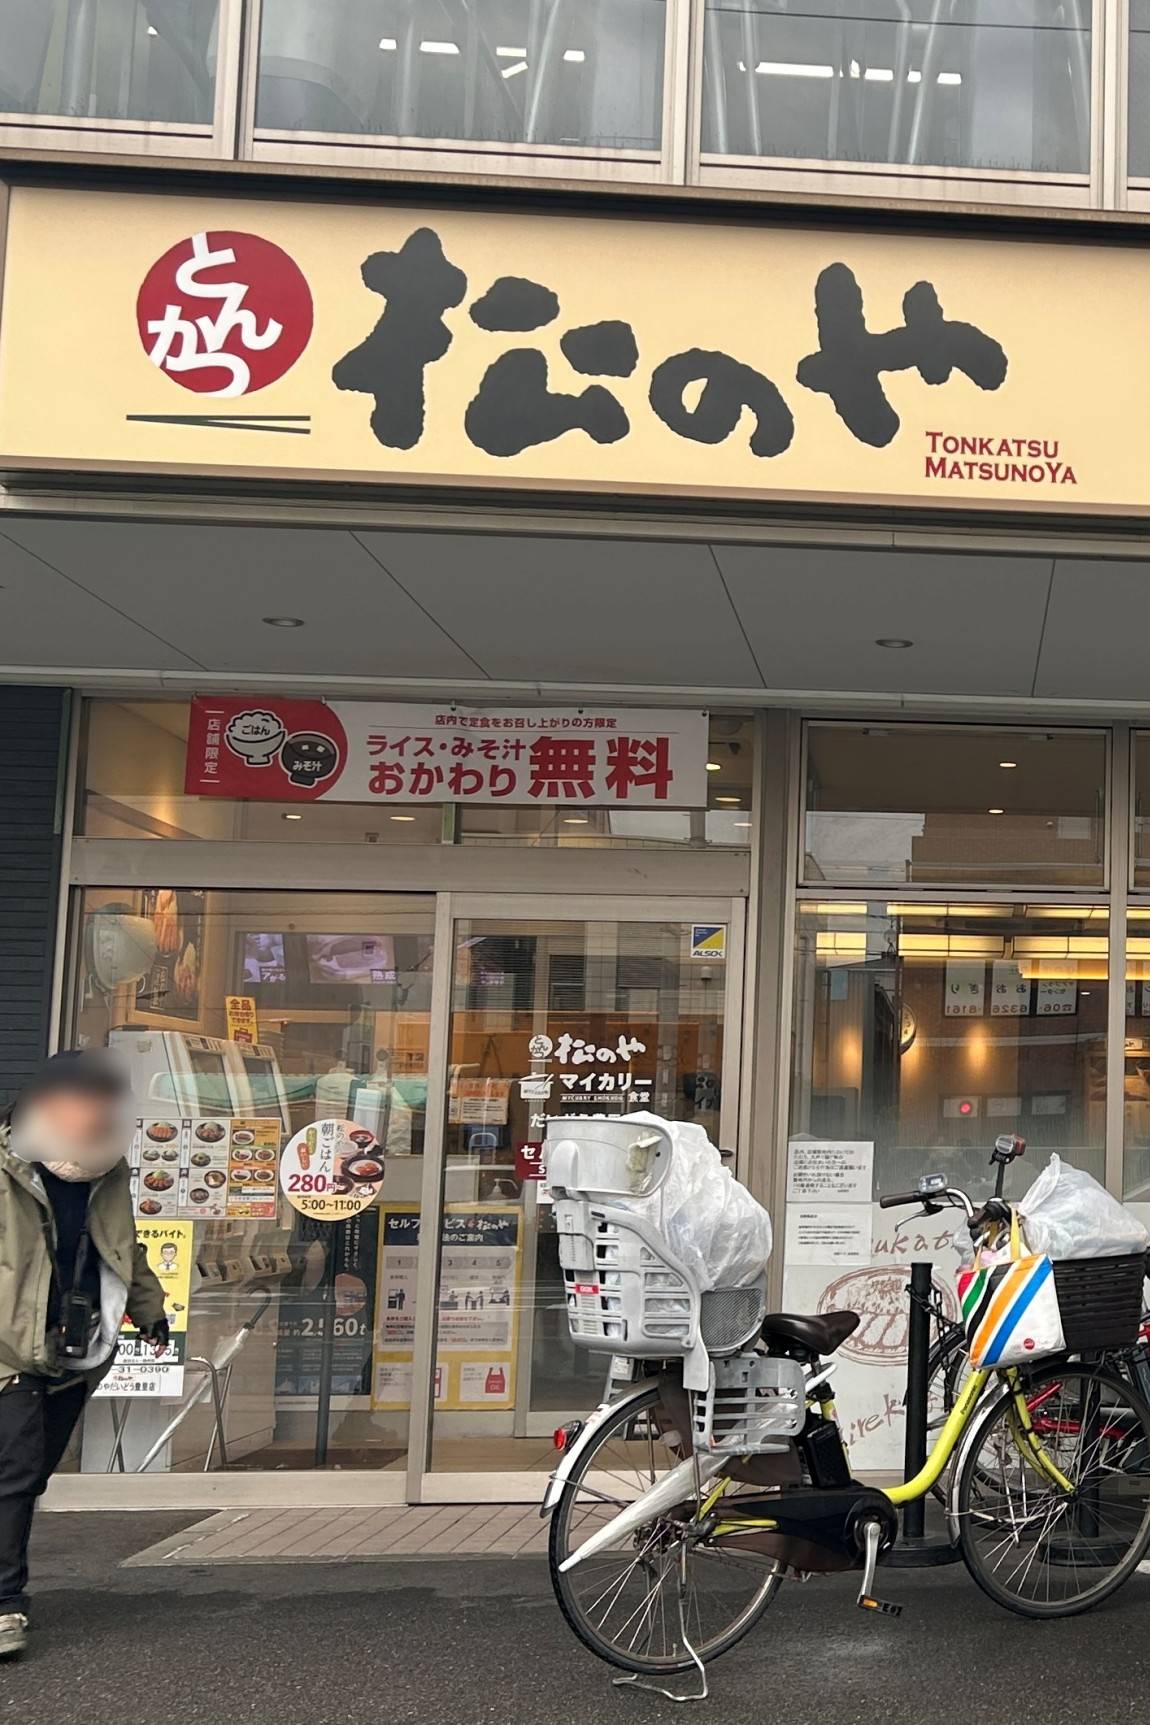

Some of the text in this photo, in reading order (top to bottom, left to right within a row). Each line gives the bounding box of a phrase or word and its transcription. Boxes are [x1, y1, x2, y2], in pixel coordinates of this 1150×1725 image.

[145, 232, 283, 398] とんかつ
[332, 226, 1008, 457] 松のや
[925, 431, 1059, 458] TONKATSU
[240, 723, 271, 737] ごはん
[434, 714, 617, 729] 店内で定食をお召し上がりの方限定
[292, 759, 323, 774] みそ汁
[528, 736, 674, 800] 無料
[368, 761, 518, 798] おかわり
[230, 999, 251, 1011] 全品
[554, 1033, 647, 1065] 松のや
[559, 1072, 653, 1092] マイカリー
[628, 1091, 650, 1103] 食堂
[319, 1122, 335, 1173] 朝ごはん
[388, 1217, 466, 1229] セルフビス
[97, 1381, 156, 1392] のやだいどう豊里店
